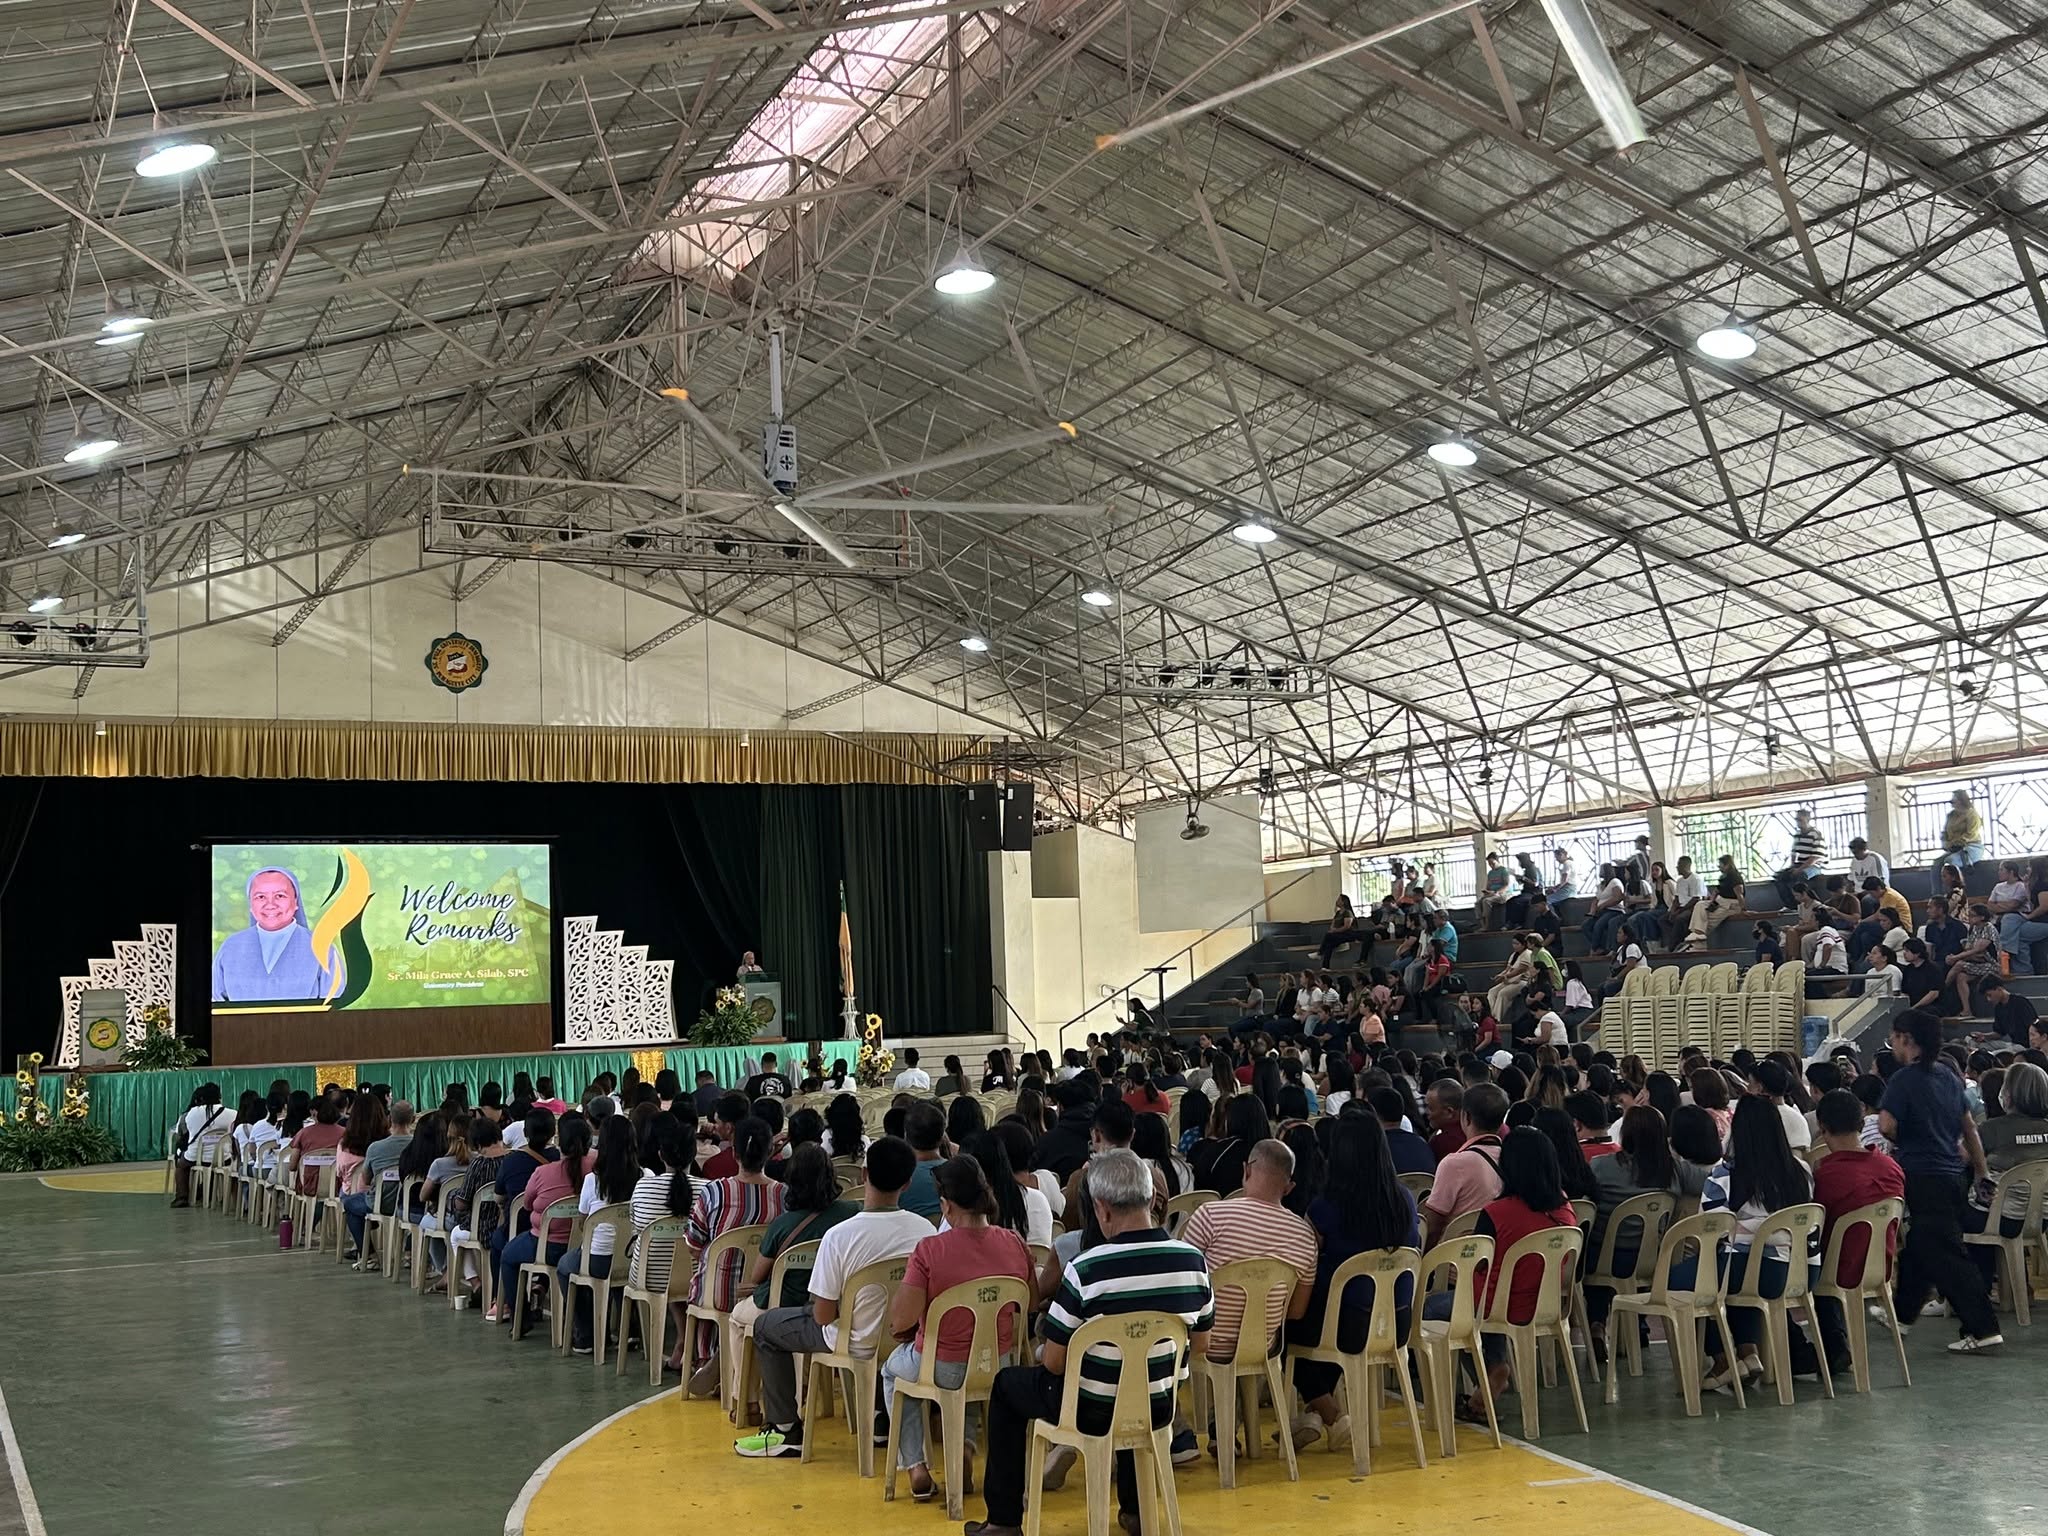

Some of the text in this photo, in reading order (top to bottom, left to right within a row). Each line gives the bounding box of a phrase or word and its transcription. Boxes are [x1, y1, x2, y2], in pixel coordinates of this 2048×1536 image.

[465, 674, 477, 685] CITY
[400, 880, 515, 914] Welcome
[405, 910, 521, 946] Remarks
[387, 972, 403, 981] Sr.
[405, 971, 429, 980] Mila
[431, 971, 462, 980] Grace
[463, 970, 475, 979] A.
[507, 968, 529, 978] SPC
[2016, 1134, 2043, 1144] HEALTH
[787, 1253, 807, 1263] G10
